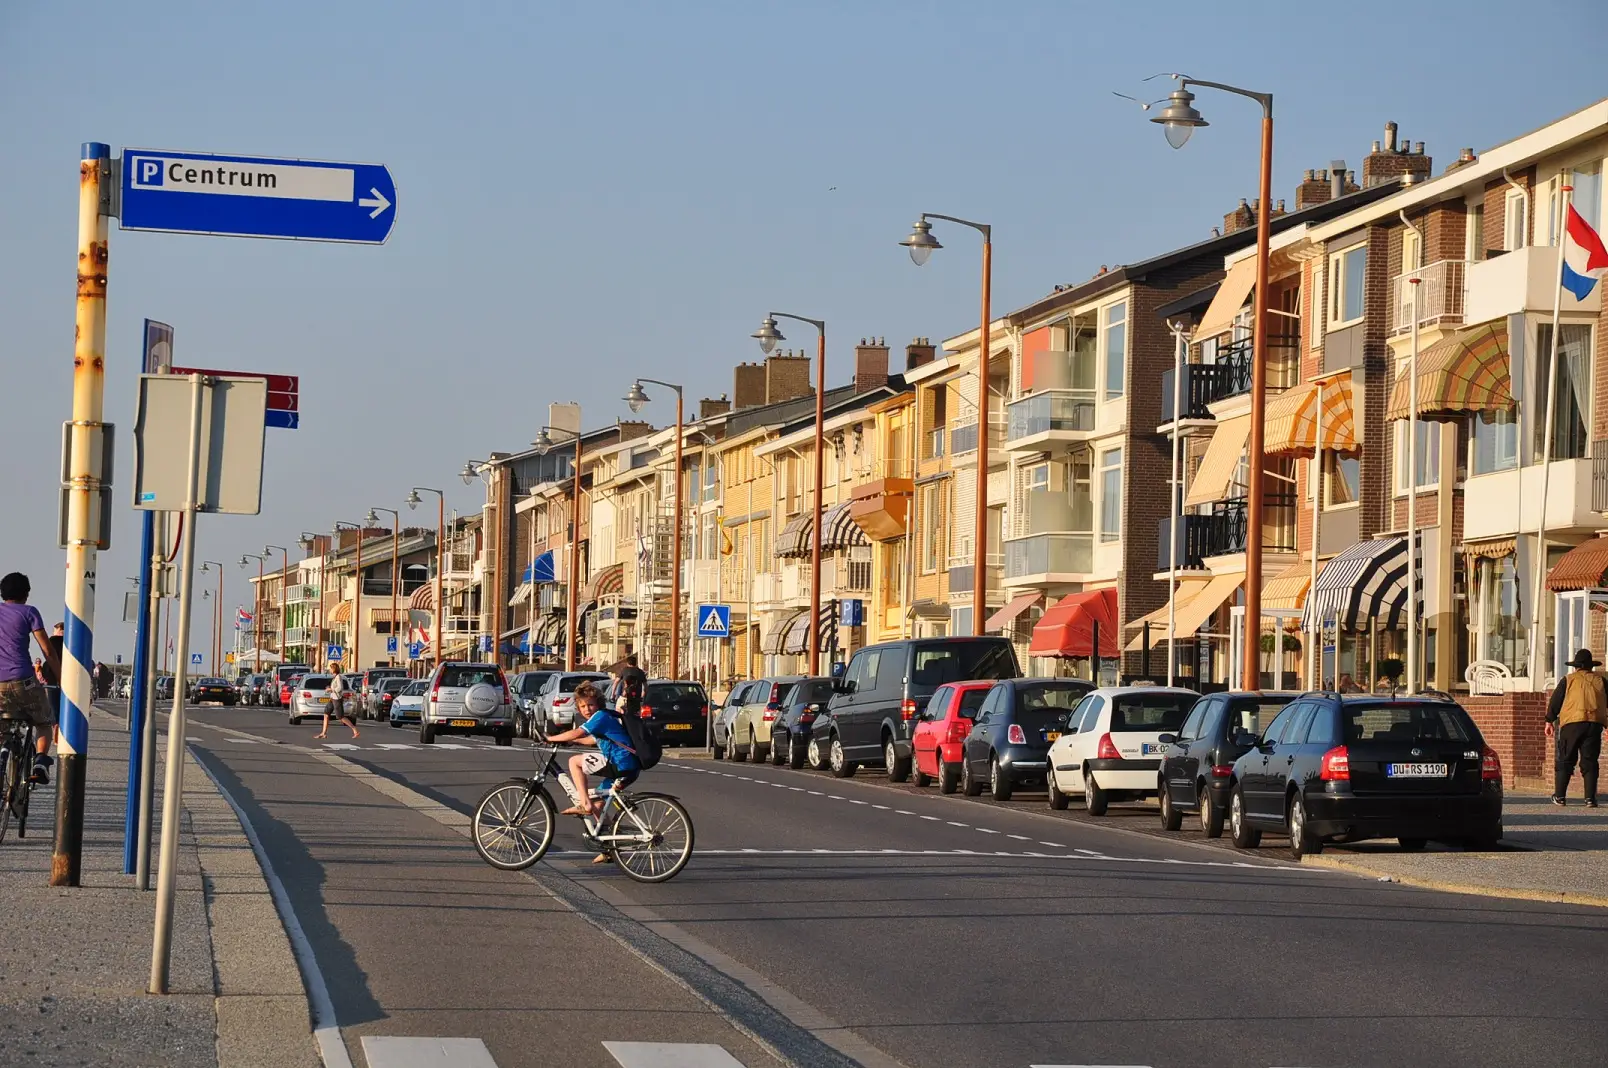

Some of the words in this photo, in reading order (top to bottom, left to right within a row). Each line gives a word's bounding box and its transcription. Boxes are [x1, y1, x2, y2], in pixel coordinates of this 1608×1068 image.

[143, 162, 158, 183] P
[168, 163, 277, 188] Centrum
[843, 602, 851, 616] P
[833, 664, 840, 673] P
[1393, 764, 1404, 775] DU
[1410, 764, 1422, 775] RS
[1424, 764, 1446, 775] 1190
